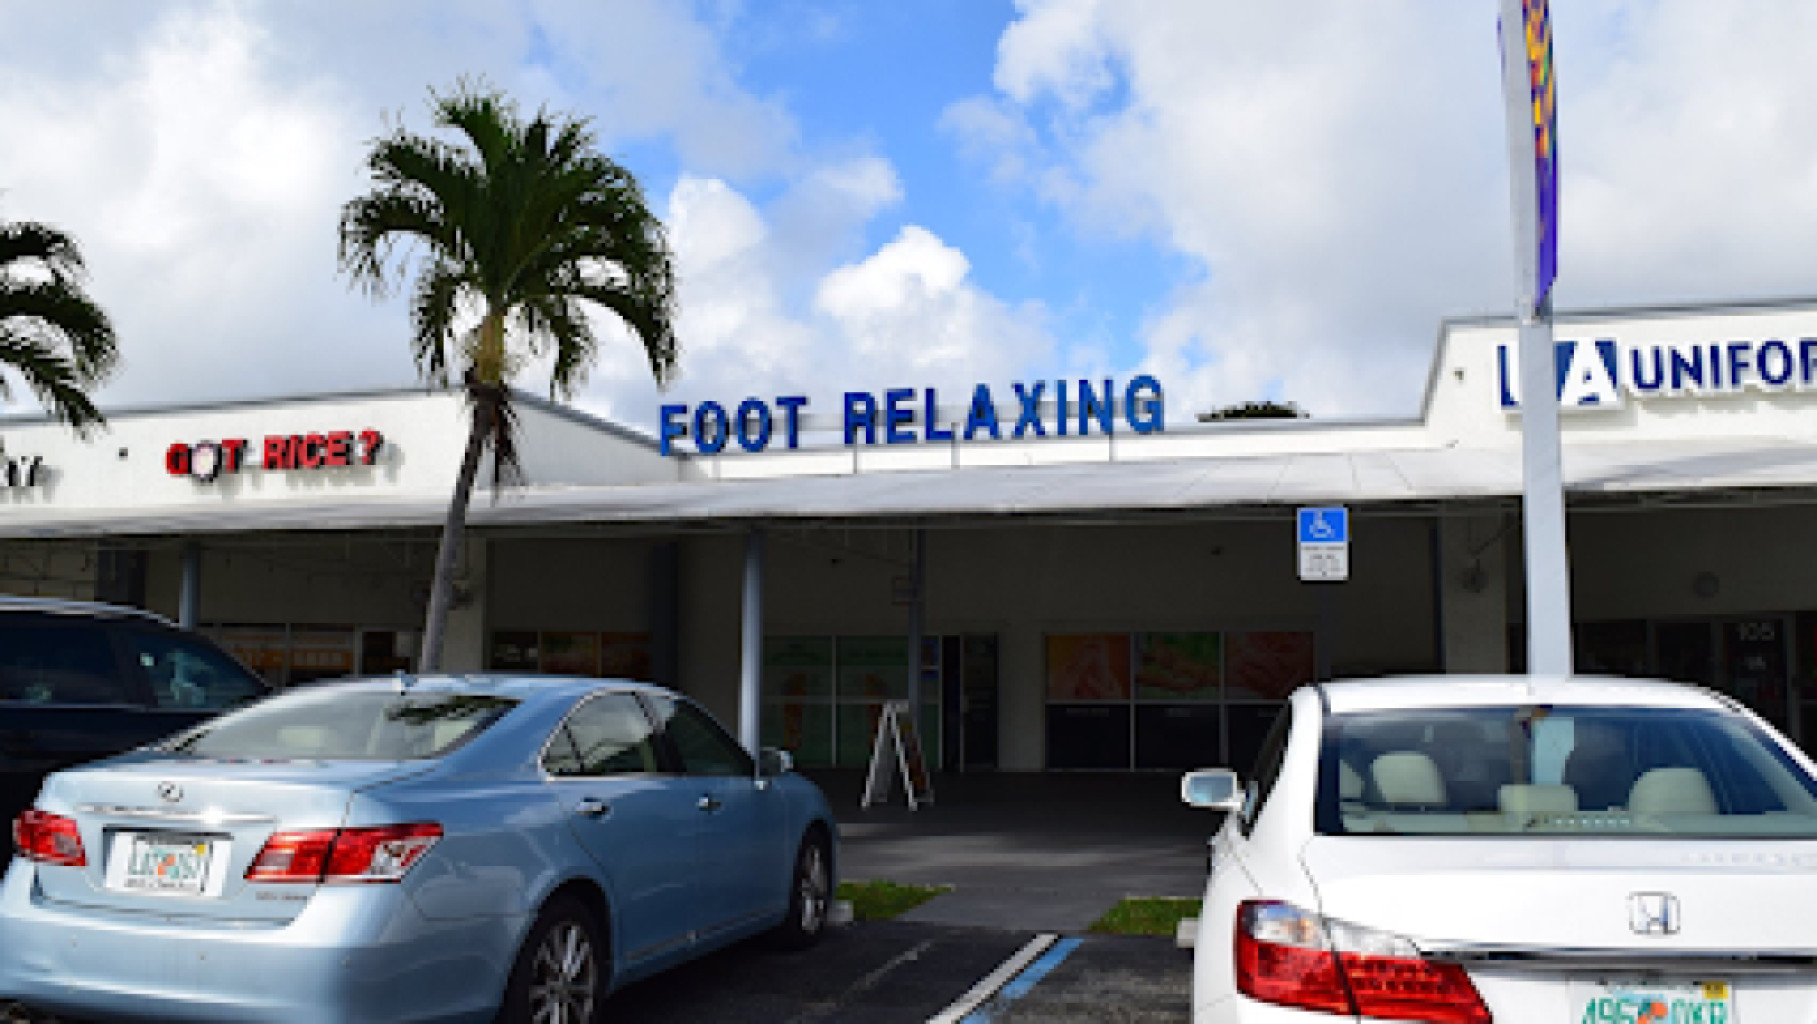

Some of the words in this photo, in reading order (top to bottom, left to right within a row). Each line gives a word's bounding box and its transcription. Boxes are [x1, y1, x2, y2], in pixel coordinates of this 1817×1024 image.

[660, 396, 808, 456] FOOT
[843, 374, 1165, 446] RELAXING
[165, 438, 249, 482] GOT
